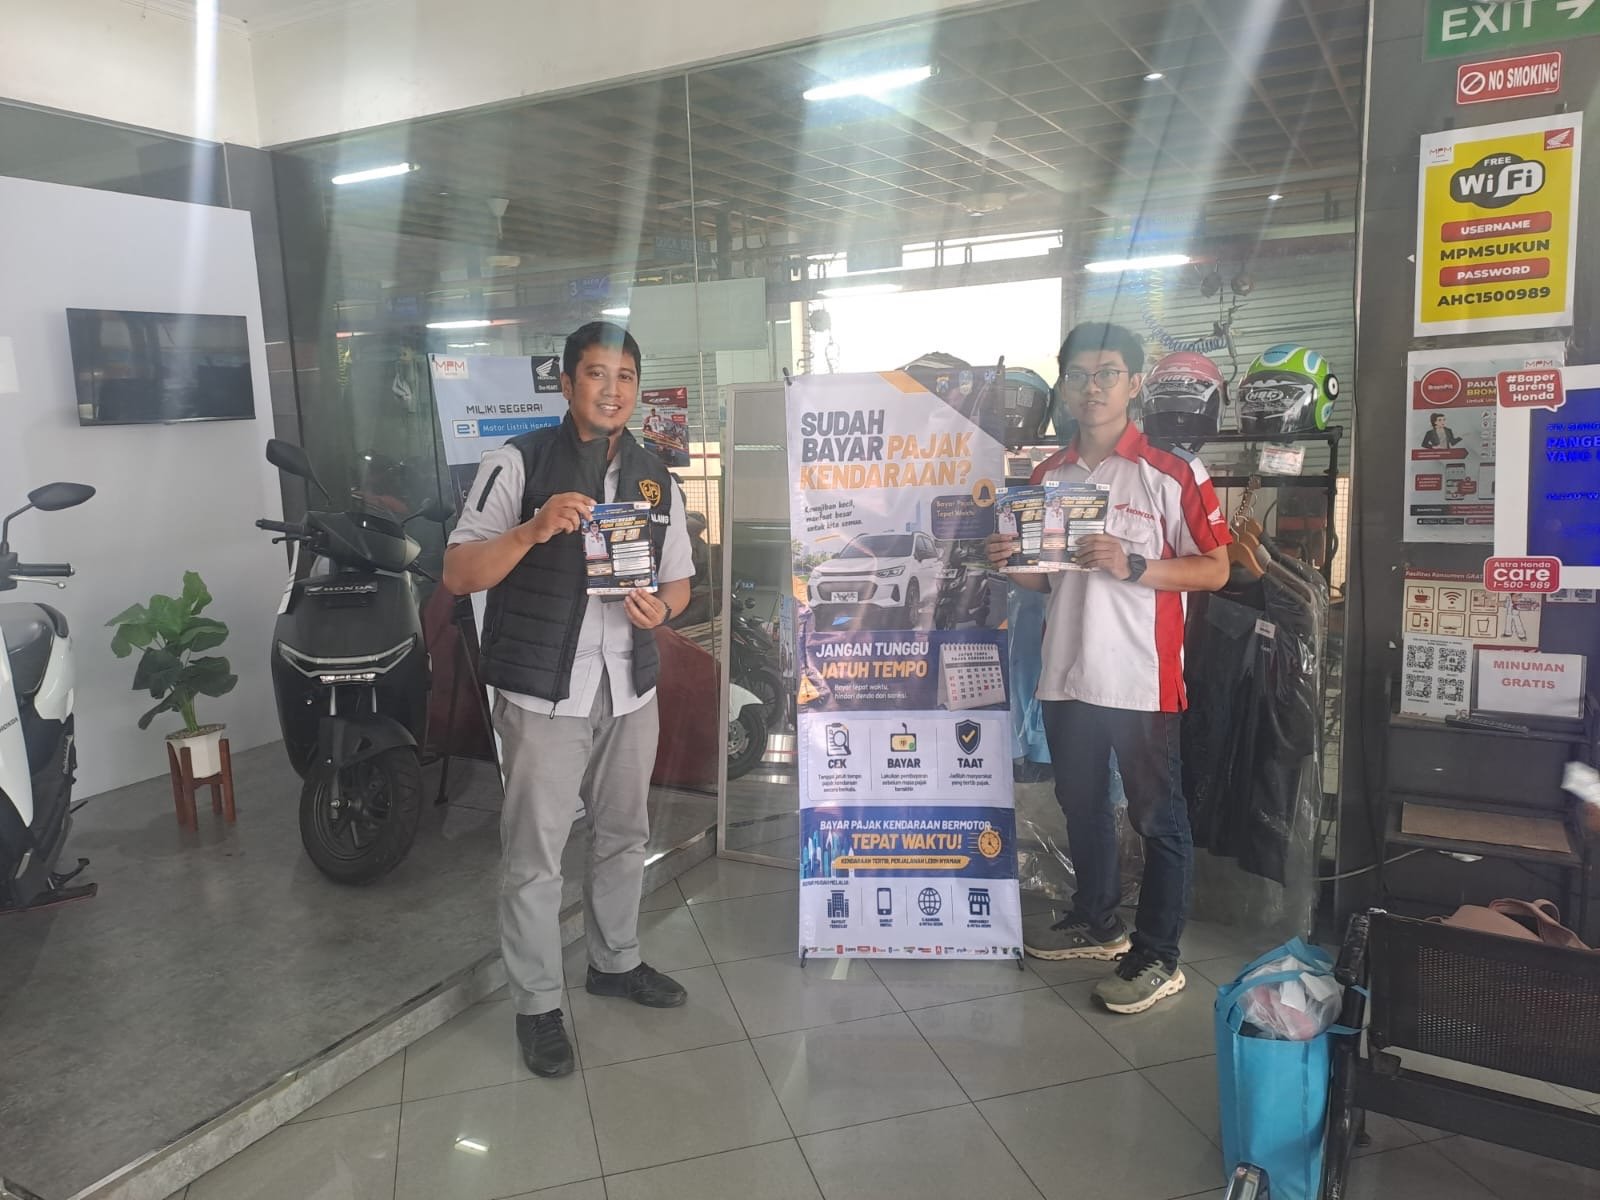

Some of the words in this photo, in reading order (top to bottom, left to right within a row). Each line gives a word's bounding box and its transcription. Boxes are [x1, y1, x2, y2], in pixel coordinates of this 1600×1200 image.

[1441, 0, 1535, 42] EXIT
[1488, 69, 1504, 91] NO
[1506, 62, 1558, 88] SMOKING
[1484, 156, 1512, 167] FREE
[1460, 219, 1532, 235] USERNAME
[1440, 239, 1550, 261] MPMSUKUN
[1456, 265, 1531, 280] PASSWORD
[1437, 286, 1551, 307] AHC1500989
[435, 360, 465, 372] MPM
[1505, 373, 1556, 384] #Baper
[1509, 383, 1555, 393] Bareng
[1512, 392, 1555, 402] Honda
[466, 405, 497, 414] MILIKI
[482, 424, 504, 432] Motor
[507, 423, 528, 431] Listrik
[800, 409, 885, 437] SUDAH
[801, 436, 884, 463] BAYAR
[887, 432, 973, 460] PAJAK
[800, 459, 973, 491] KENDARAAN?
[1125, 507, 1155, 521] HONDA
[1493, 568, 1550, 581] care
[1493, 581, 1551, 589] 1-500-989
[816, 642, 873, 658] JANGAN
[875, 641, 930, 656] TUNGGU
[820, 661, 870, 679] JATUH
[872, 660, 928, 678] TEMPO
[1492, 660, 1565, 673] MINUMAN
[1501, 677, 1556, 690] GRATIS
[827, 759, 848, 769] CEK
[887, 758, 921, 769] BAYAR
[957, 757, 984, 769] TAAT
[819, 820, 850, 831] BAYAR
[850, 820, 882, 830] PAJAK
[883, 820, 940, 830] KENDARAAN
[852, 833, 899, 850] TEPAT
[901, 833, 962, 850] WAKTU!
